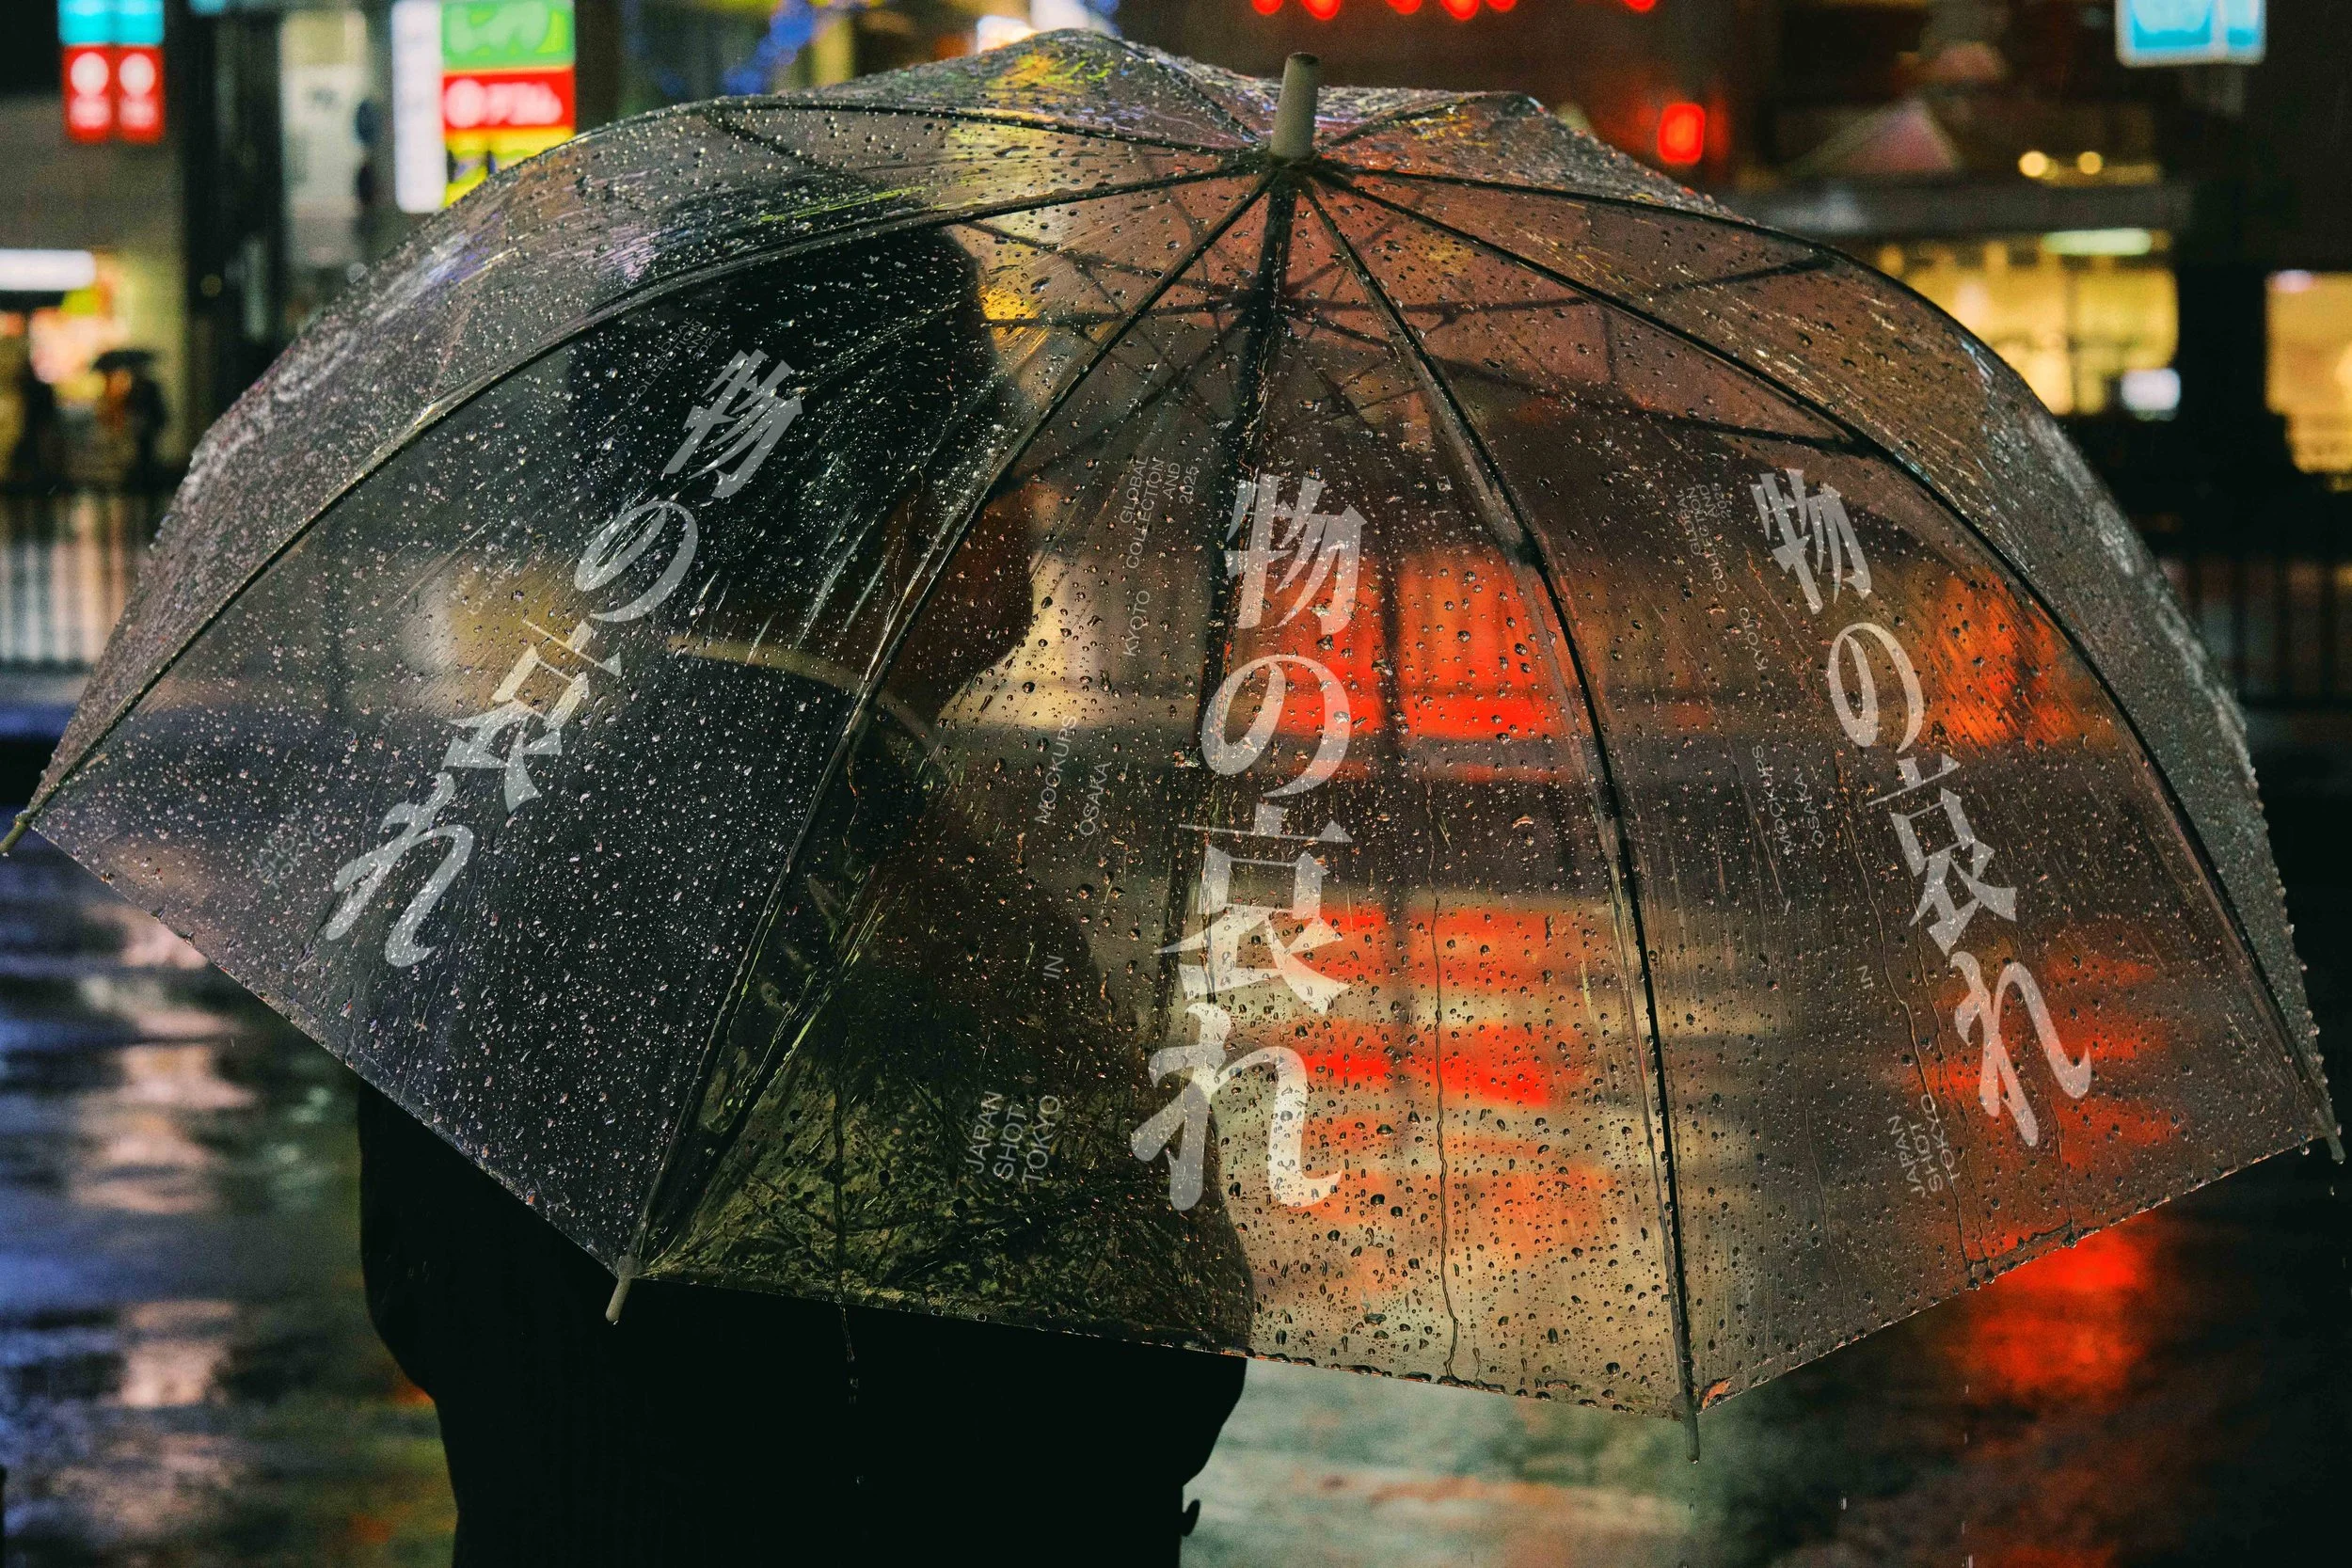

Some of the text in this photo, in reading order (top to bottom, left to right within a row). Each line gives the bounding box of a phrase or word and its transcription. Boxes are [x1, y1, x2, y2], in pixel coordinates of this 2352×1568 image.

[628, 321, 703, 406] COLLECTION
[645, 317, 695, 370] GLOBAL
[685, 325, 711, 355] AND
[692, 330, 722, 361] 2025
[1120, 455, 1149, 524] GLOBAL
[1126, 457, 1165, 569] COLLECTION
[1163, 462, 1181, 499] AND
[1179, 466, 1199, 505] 2025
[1698, 483, 1719, 518] AND
[1686, 486, 1727, 594] COLLECTION
[326, 349, 803, 967] 物の哀れ
[1122, 590, 1150, 657] KYOTO
[1740, 607, 1768, 671] KYOTO
[1035, 715, 1077, 825] MOCKUPS
[1079, 762, 1112, 836] OSAKA
[1750, 467, 2091, 1147] 物の哀れ
[1752, 745, 1794, 856] MOCKUPS
[1131, 473, 1367, 1211] 物の哀れ
[1793, 772, 1825, 847] OSAKA
[1042, 955, 1064, 980] IN
[1856, 965, 1874, 990] IN
[965, 1091, 1003, 1174] JAPAN
[993, 1105, 1025, 1181] SHOT
[1022, 1095, 1060, 1181] TOKYO
[1887, 1115, 1926, 1198] JAPAN
[1909, 1121, 1943, 1193] SHOT
[1920, 1094, 1961, 1180] TOKYO
